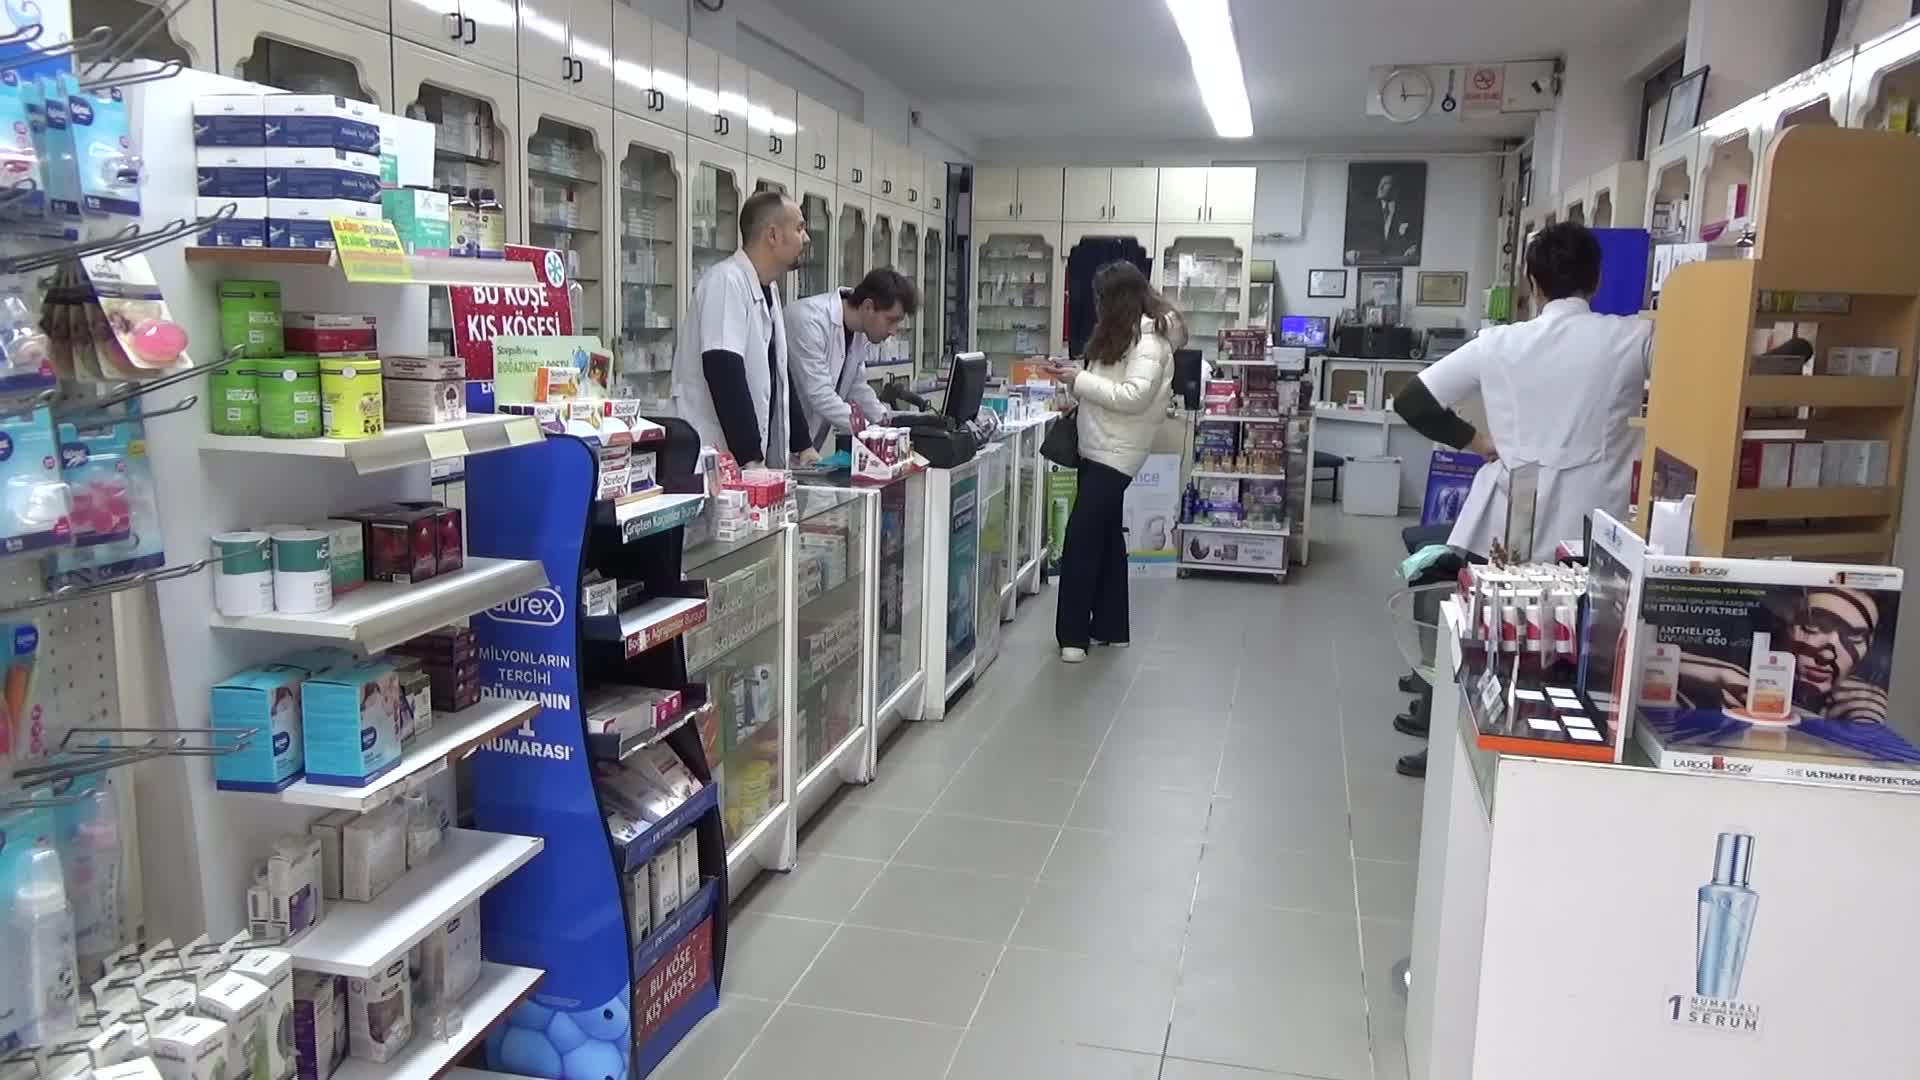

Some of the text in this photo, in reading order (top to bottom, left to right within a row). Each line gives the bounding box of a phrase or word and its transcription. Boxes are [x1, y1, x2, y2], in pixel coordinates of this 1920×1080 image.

[479, 645, 571, 669] MİLYONLARIN
[499, 668, 551, 684] TERCİHİ
[1805, 769, 1856, 782] ULTIMATE
[650, 971, 664, 998] BU
[646, 997, 662, 1025] KIŞ
[1688, 1011, 1757, 1031] SERUM
